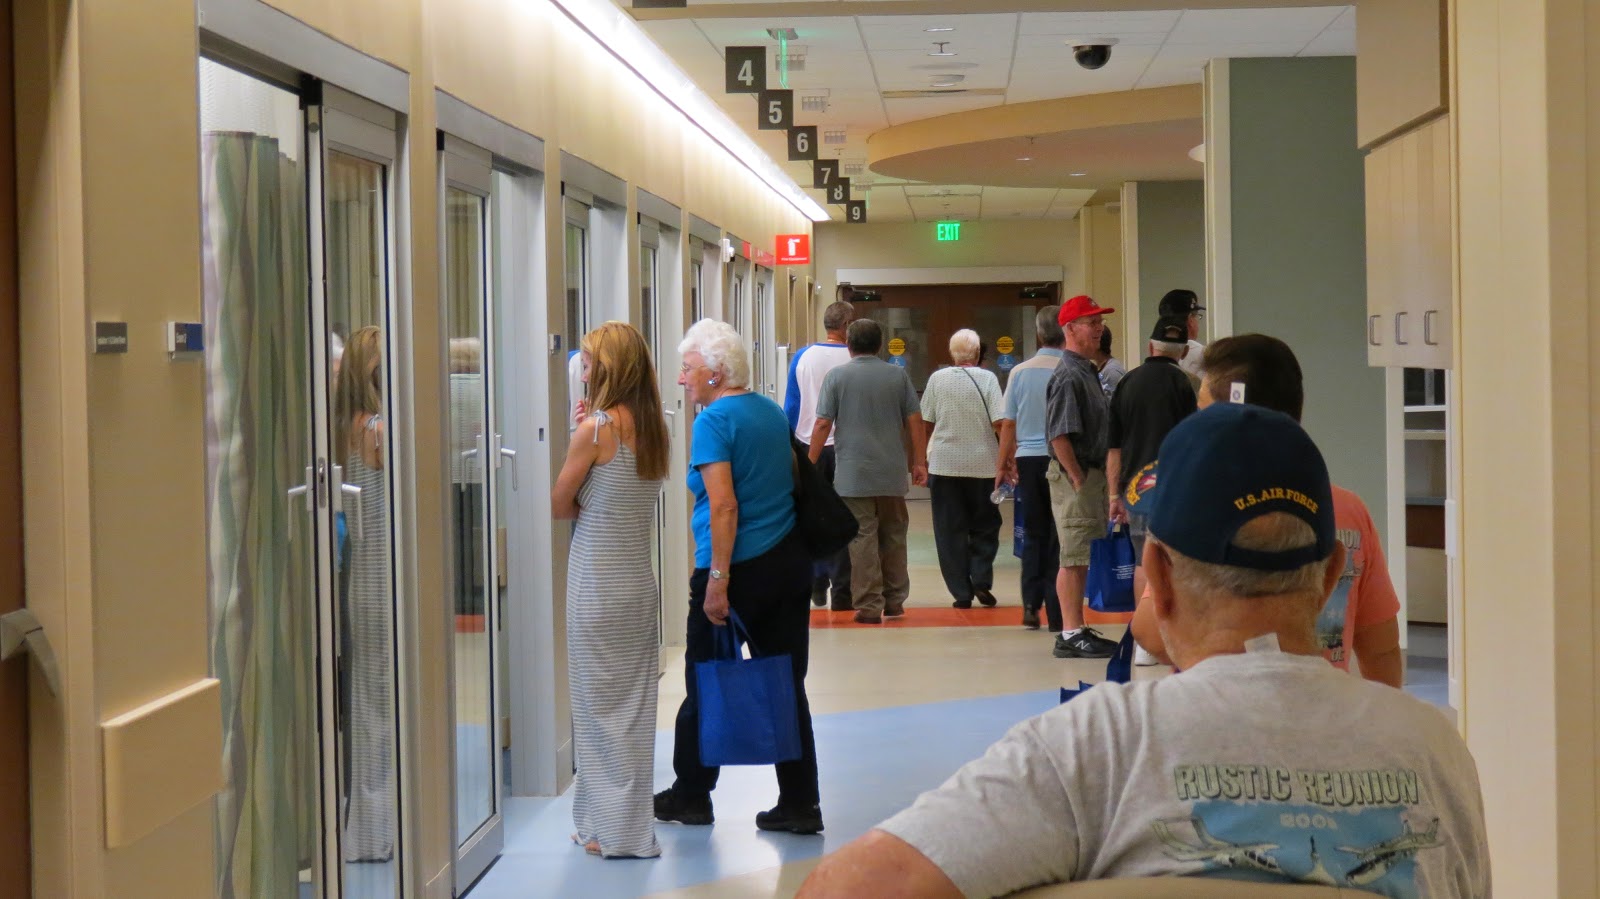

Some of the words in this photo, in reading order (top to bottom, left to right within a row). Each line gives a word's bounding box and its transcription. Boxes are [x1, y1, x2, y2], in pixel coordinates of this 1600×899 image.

[737, 60, 754, 86] 4
[768, 100, 782, 124] 5
[796, 132, 809, 153] 6
[820, 167, 831, 184] 7
[833, 184, 843, 200] 8
[852, 206, 861, 220] 9
[937, 223, 961, 241] EXIT
[1286, 488, 1319, 514] FORCE
[1173, 764, 1291, 803] RUSTIC
[1296, 767, 1420, 806] REUNION
